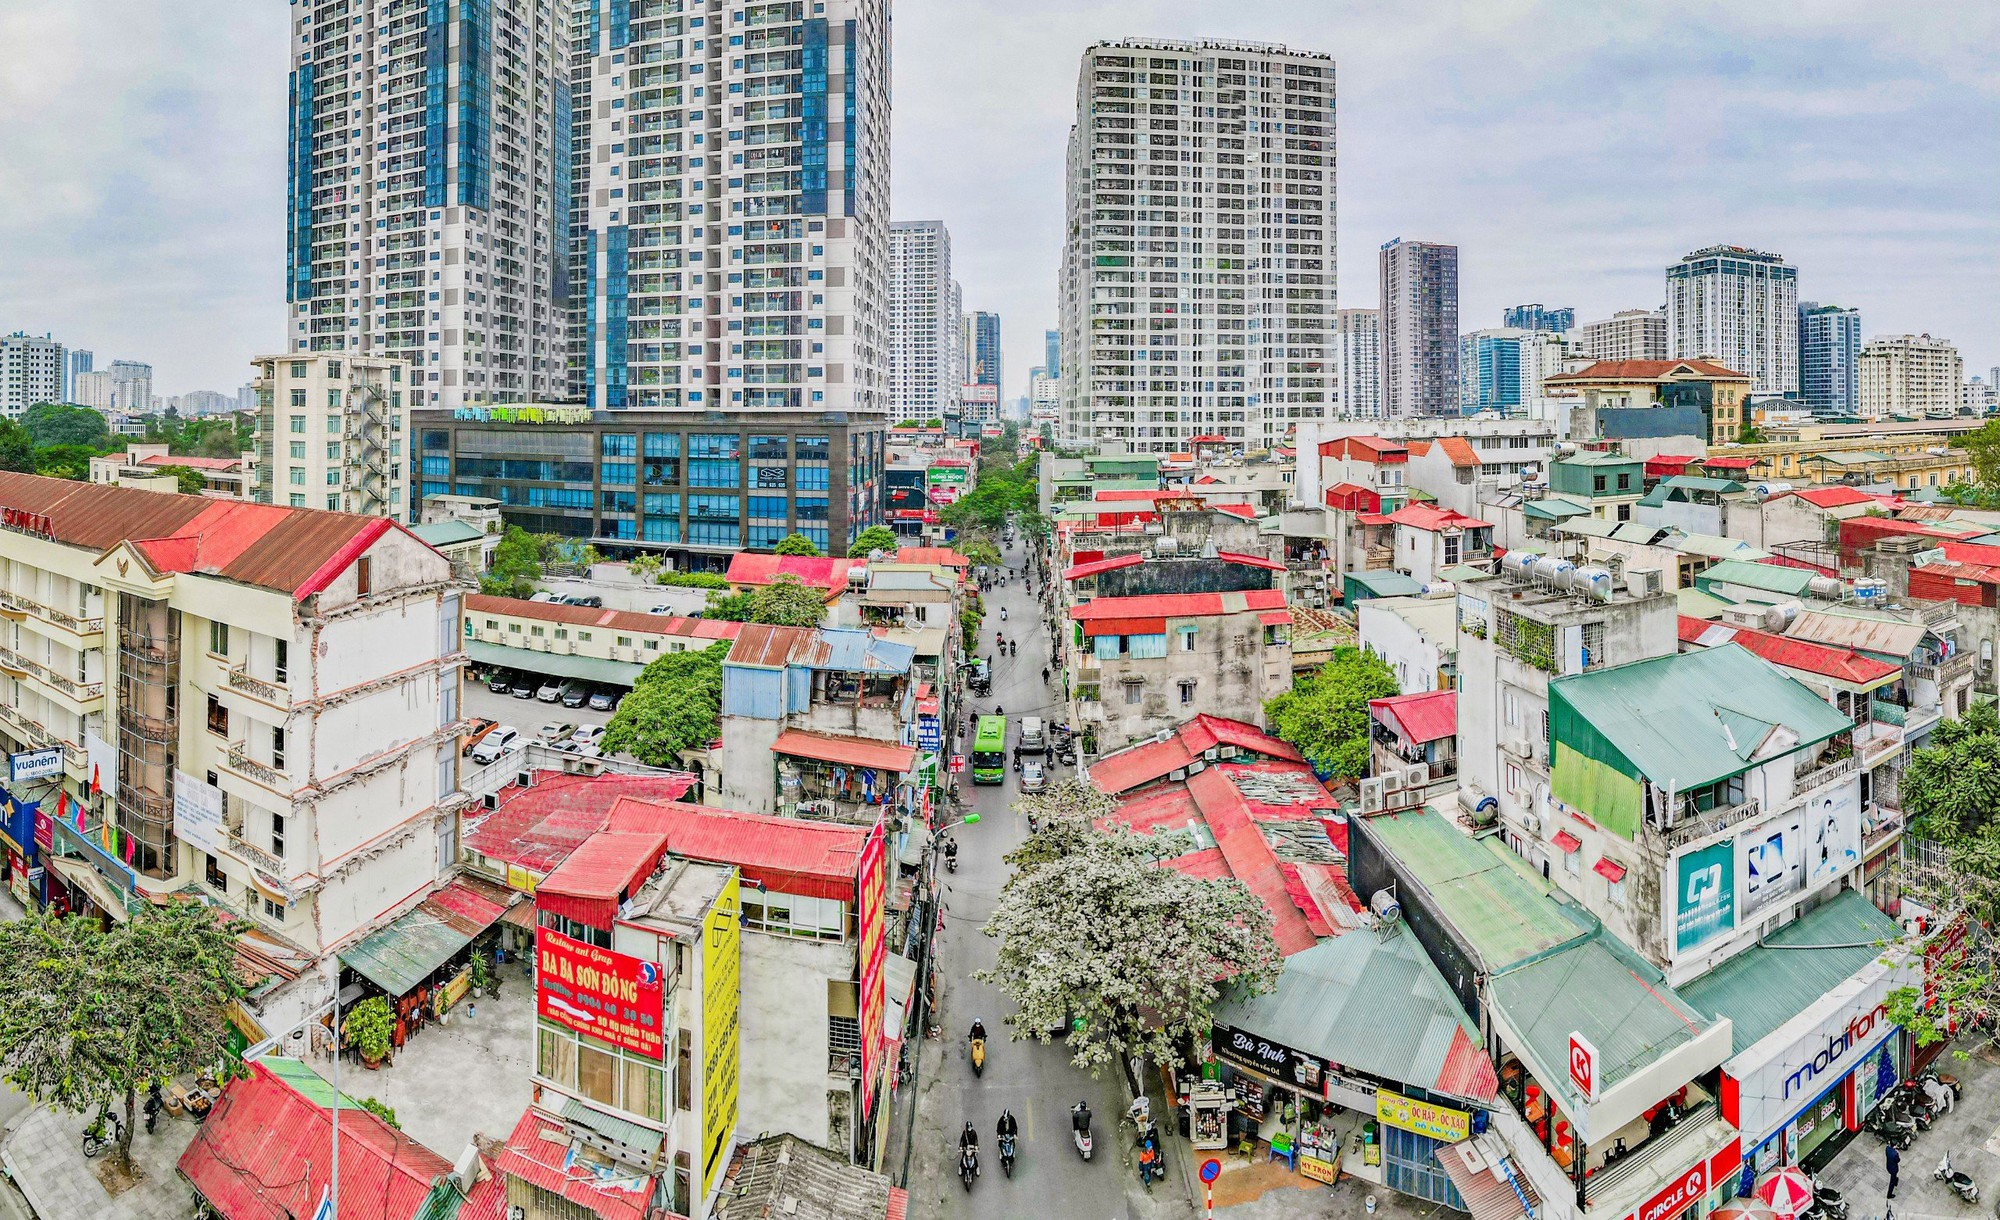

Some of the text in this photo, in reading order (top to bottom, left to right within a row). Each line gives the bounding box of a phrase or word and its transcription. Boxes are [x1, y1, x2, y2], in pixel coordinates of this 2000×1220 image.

[16, 755, 58, 771] vuanêm
[542, 950, 558, 976] BA
[559, 956, 575, 985] BA
[576, 963, 600, 993] SƠN
[1232, 1032, 1255, 1052] Bà
[1257, 1041, 1287, 1064] Anh
[1784, 1003, 1889, 1100] mobifon
[1411, 1101, 1421, 1119] ỐC
[1422, 1105, 1436, 1121] HẤP
[1440, 1109, 1450, 1126] ỐC
[1645, 1189, 1684, 1220] CIRCLE
